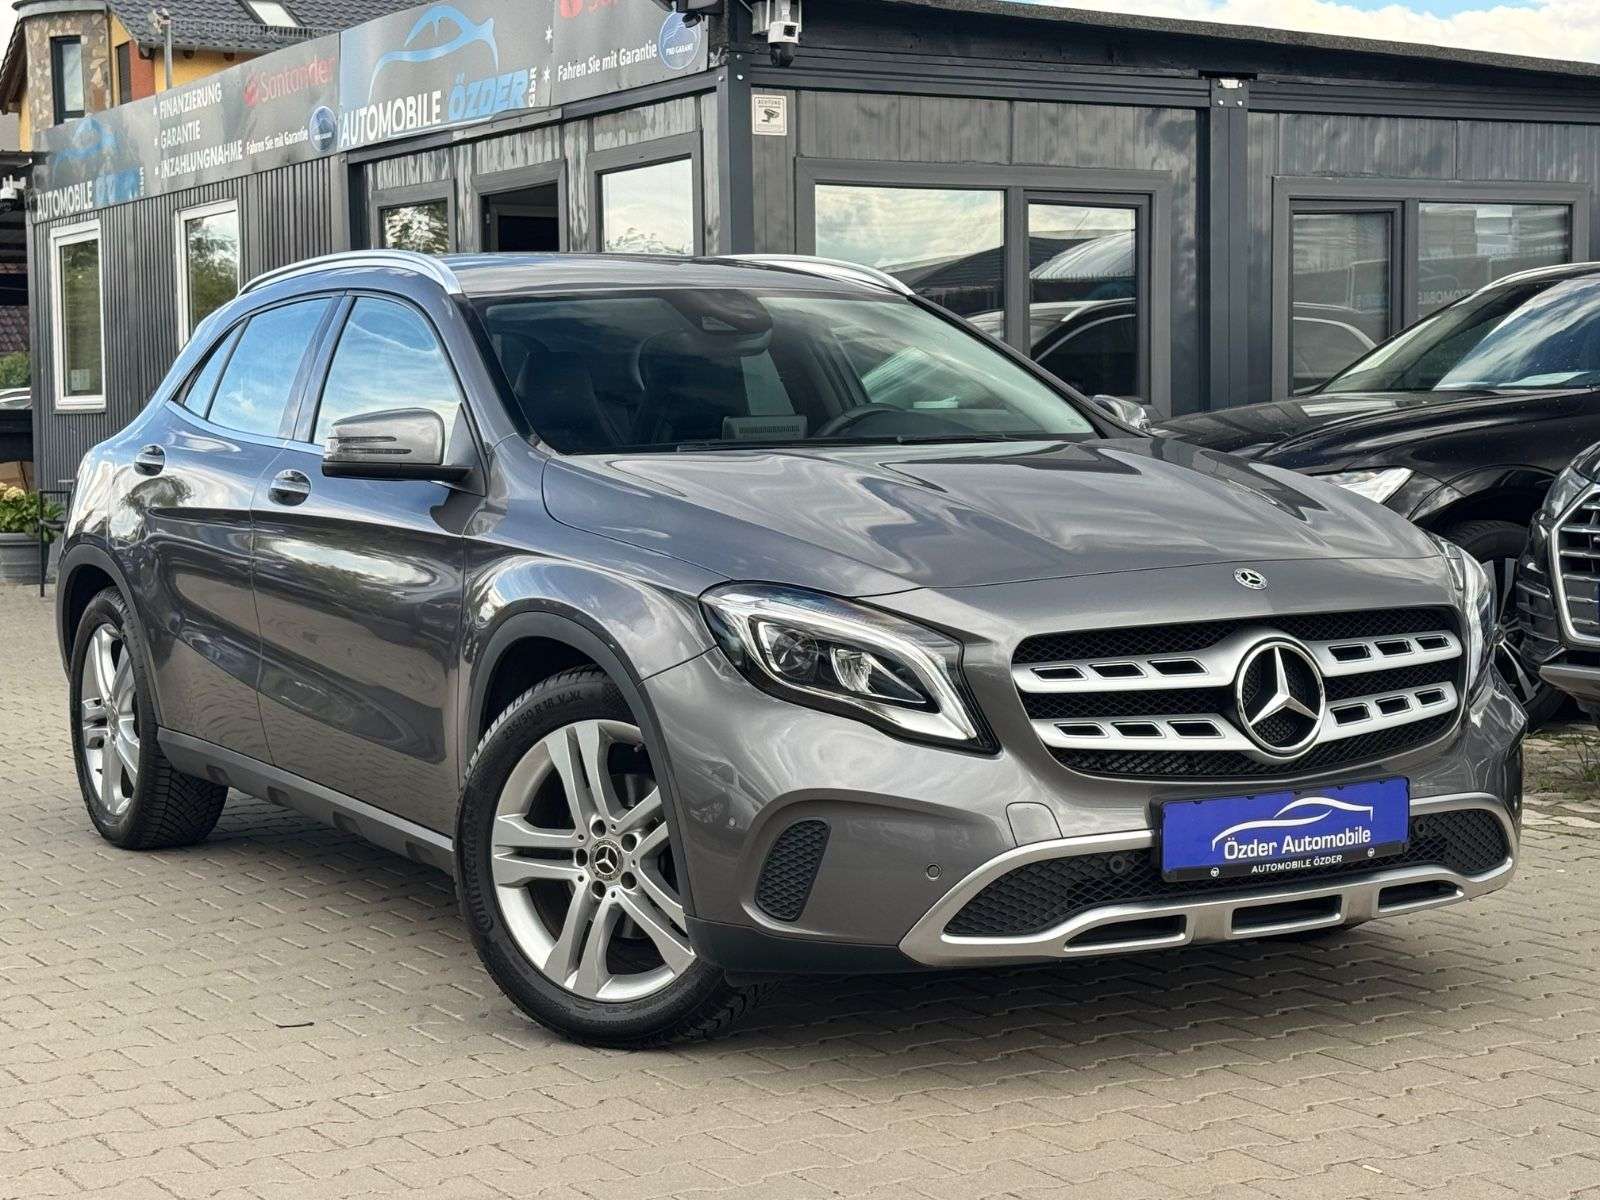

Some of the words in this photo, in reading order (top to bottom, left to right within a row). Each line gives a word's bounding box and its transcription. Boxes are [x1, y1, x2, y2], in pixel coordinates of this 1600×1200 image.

[558, 61, 587, 82] Fahren
[588, 54, 600, 75] Sie
[602, 50, 618, 71] mit
[619, 40, 658, 66] Garantie
[159, 82, 222, 120] FINANZIERUNG
[340, 90, 442, 147] AUTOMOBILE
[448, 69, 530, 121] ÖZDER
[160, 119, 201, 149] GARANTIE
[161, 139, 243, 179] INZAHLUNGNAHME
[36, 180, 94, 221] AUTOMOBILE
[1223, 836, 1278, 860] Özder
[1281, 825, 1372, 854] Automobile
[1250, 858, 1311, 874] AUTOMOBILE
[1313, 854, 1343, 868] ÖZDER
